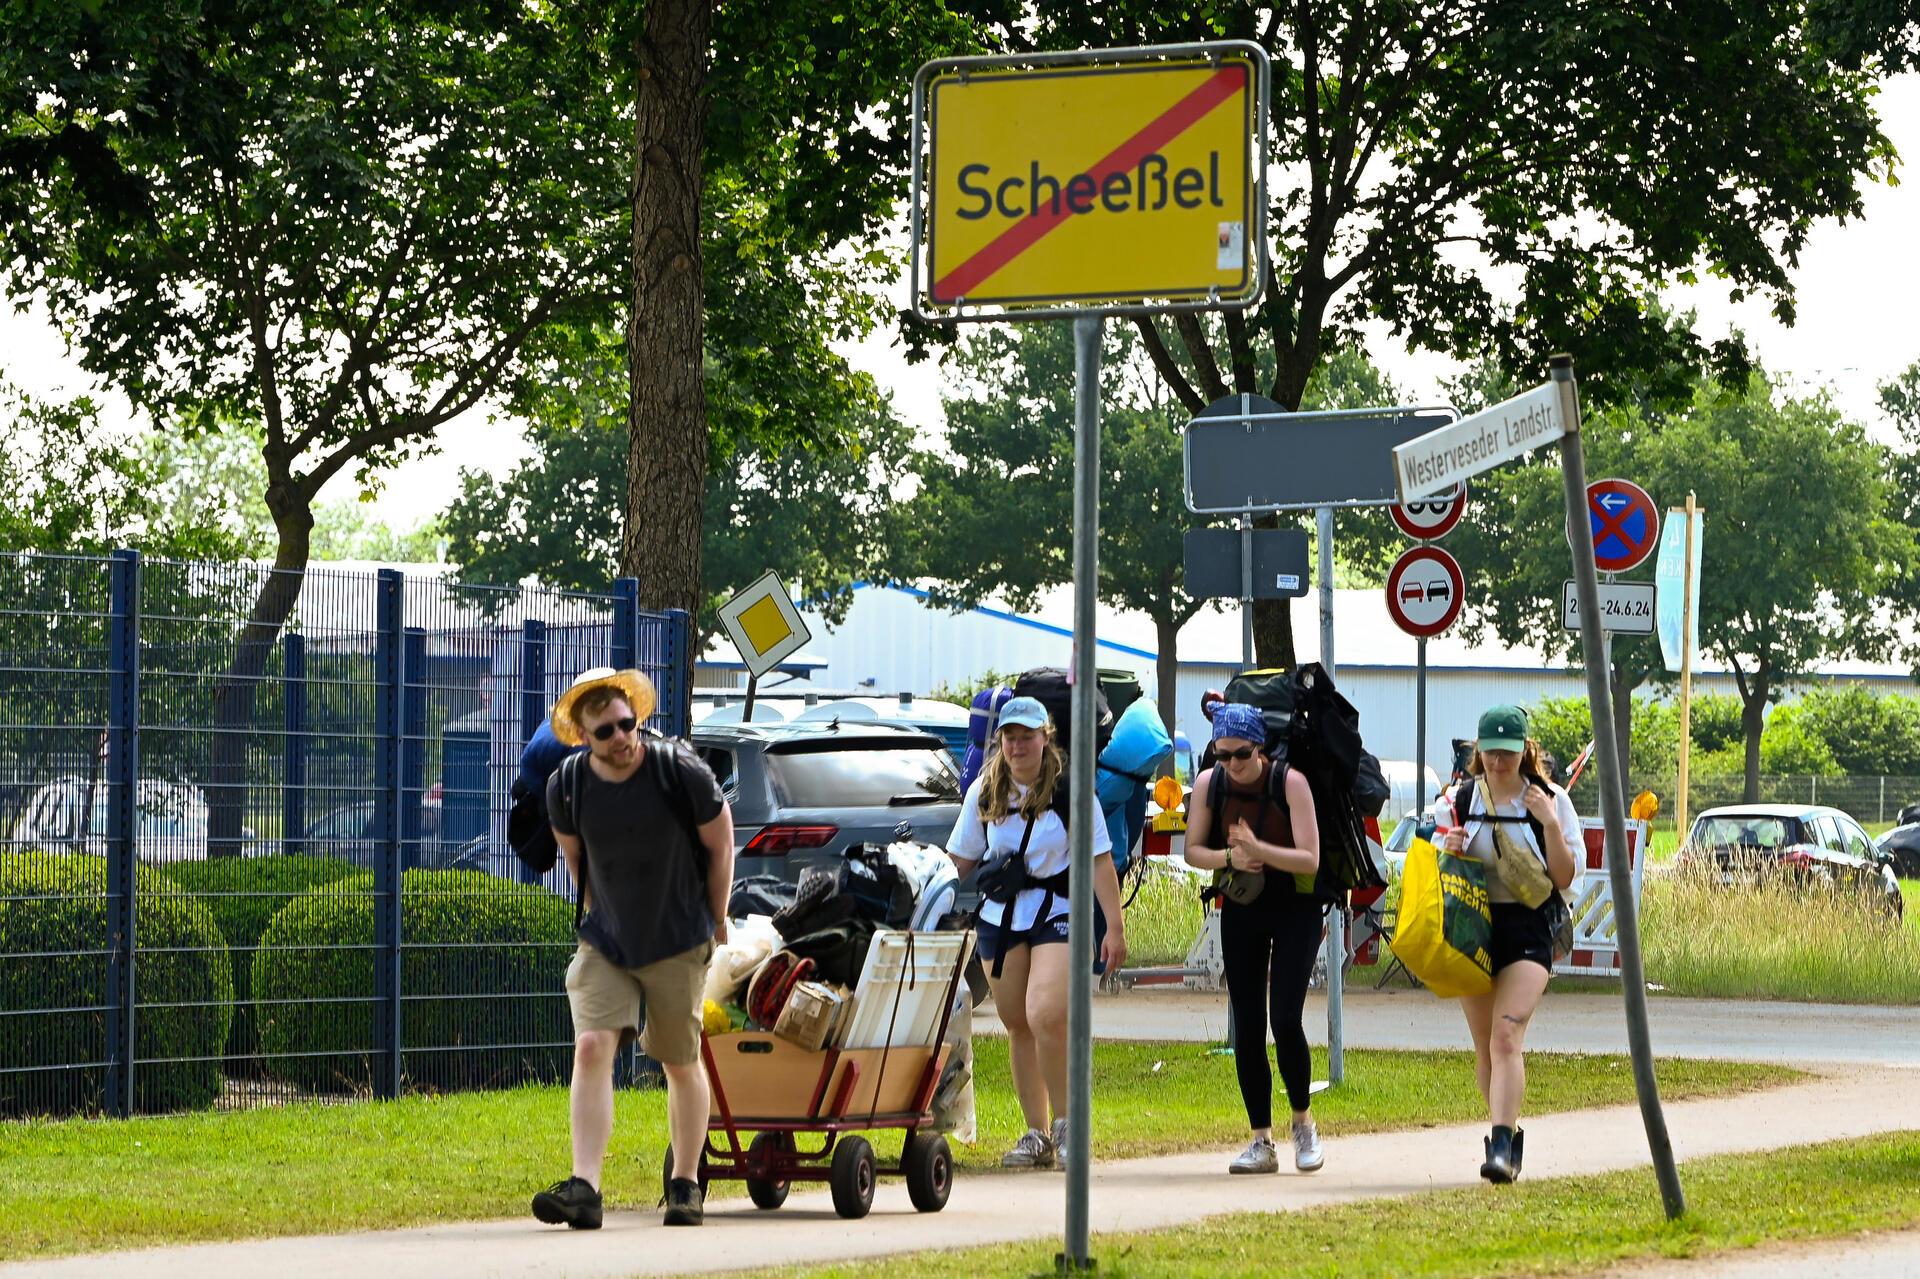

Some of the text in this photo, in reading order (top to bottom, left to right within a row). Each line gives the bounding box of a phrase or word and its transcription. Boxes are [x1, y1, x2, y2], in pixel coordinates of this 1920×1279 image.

[955, 150, 1224, 220] Scheeßel
[1404, 402, 1557, 489] Westerveseder Landstr.
